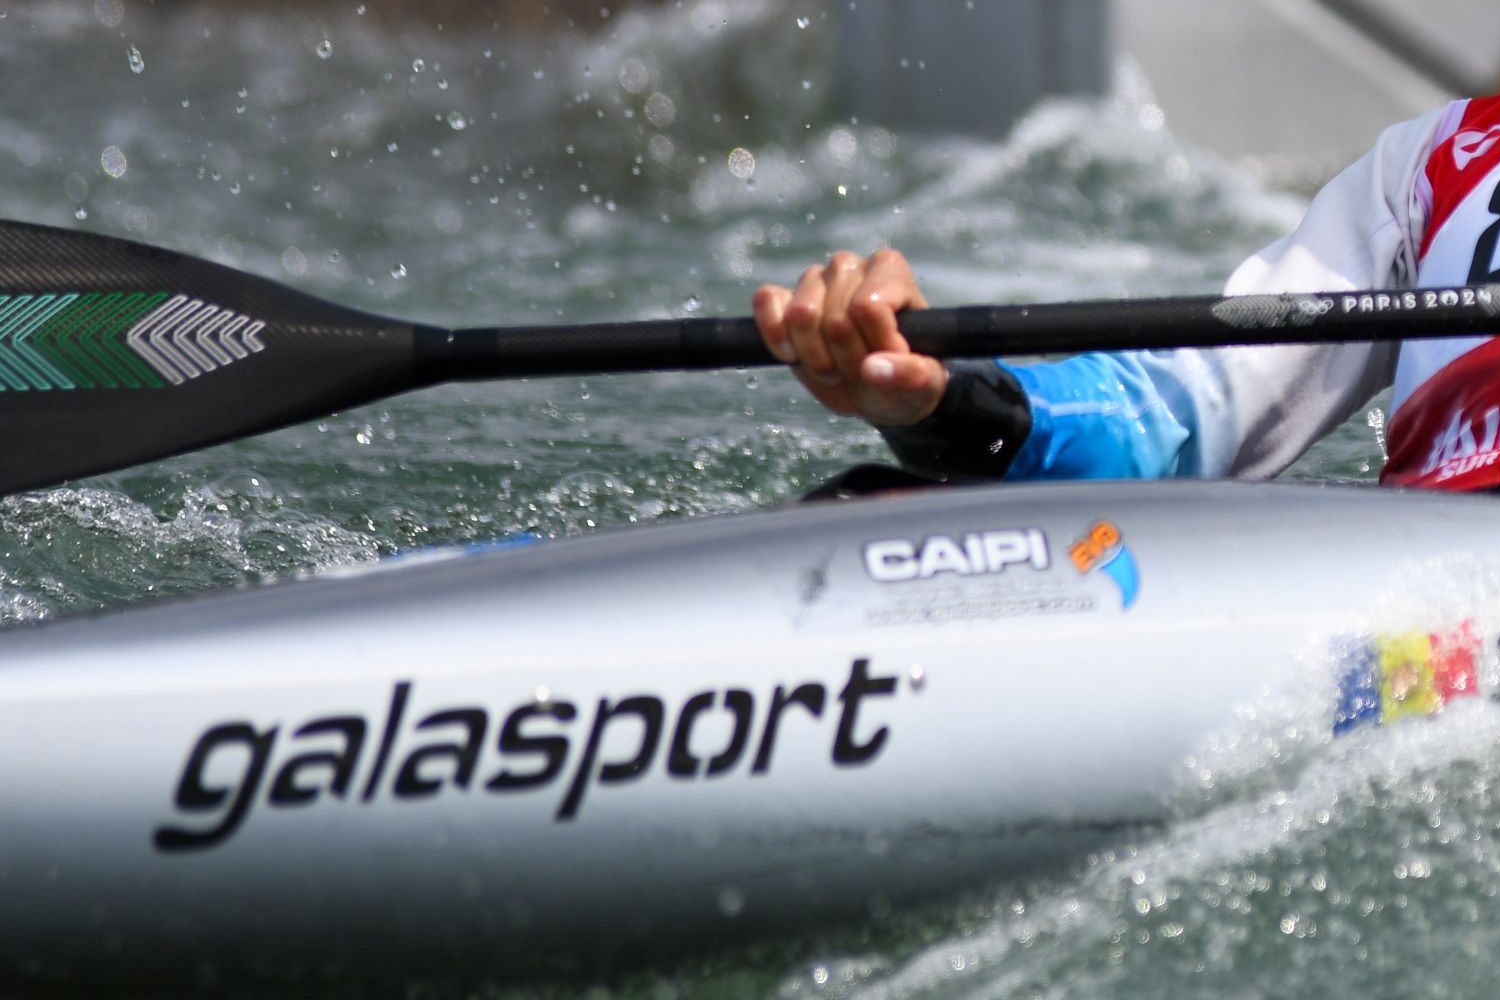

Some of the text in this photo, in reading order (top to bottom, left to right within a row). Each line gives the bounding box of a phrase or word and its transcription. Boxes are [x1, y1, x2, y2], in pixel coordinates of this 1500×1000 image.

[1342, 289, 1491, 313] PARIS 2024
[864, 527, 1050, 583] CAIPI
[152, 657, 899, 853] galasport
